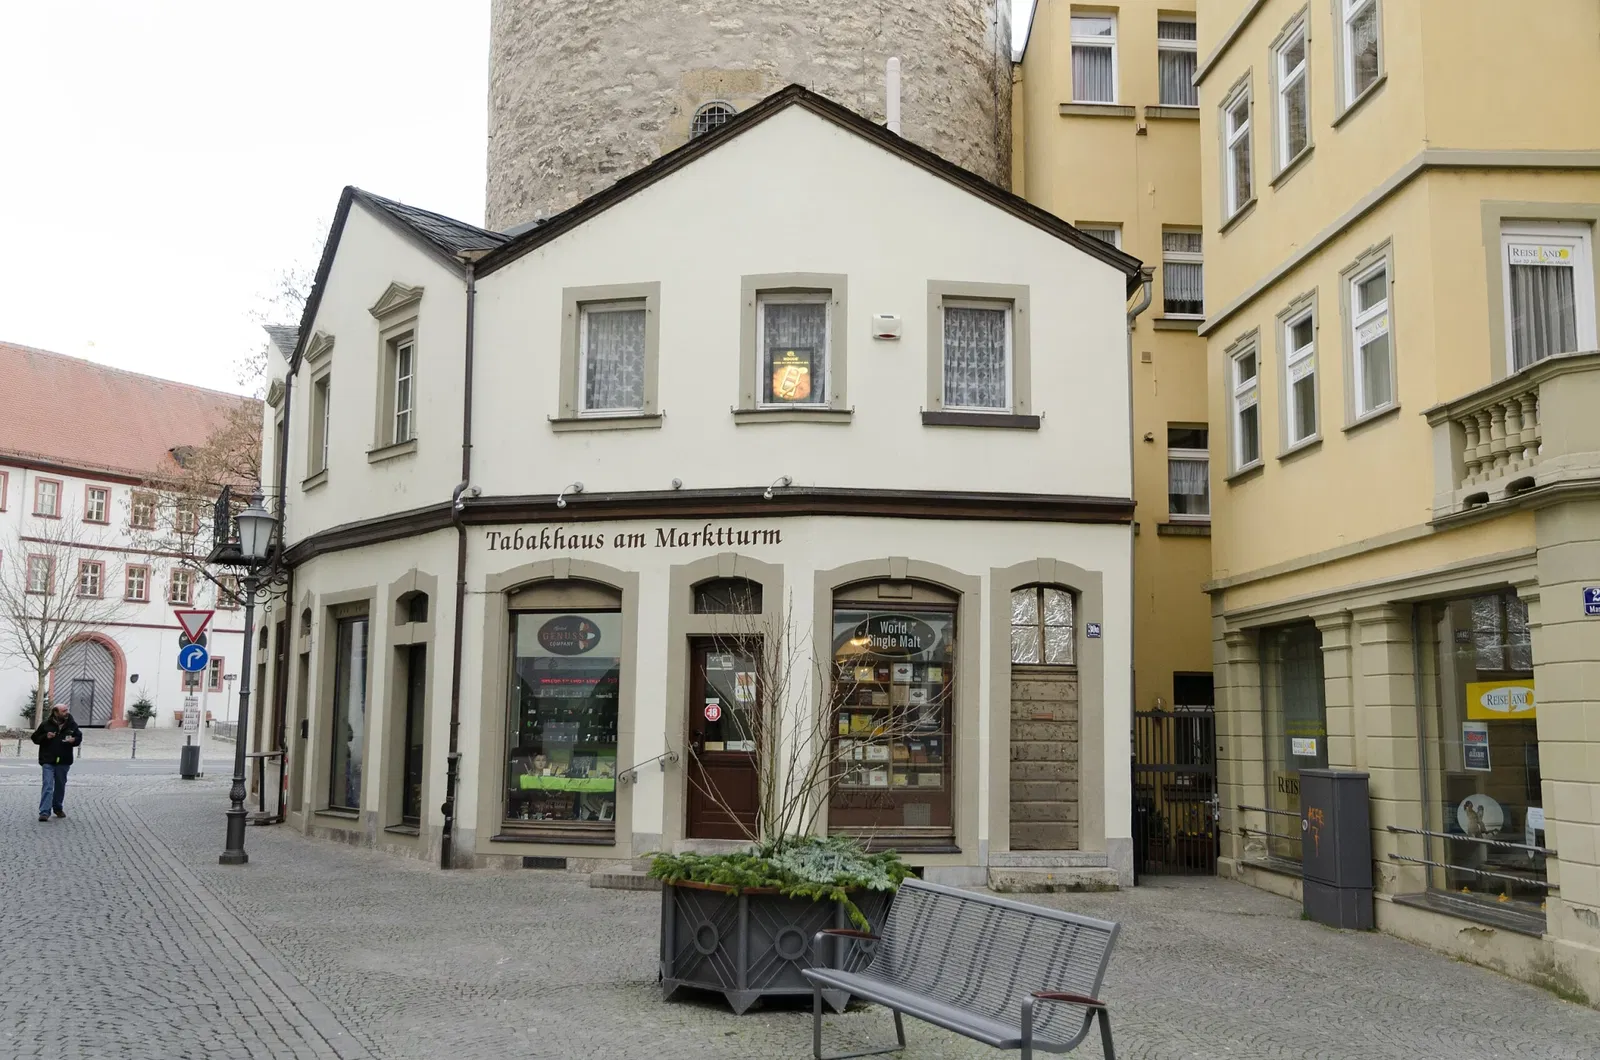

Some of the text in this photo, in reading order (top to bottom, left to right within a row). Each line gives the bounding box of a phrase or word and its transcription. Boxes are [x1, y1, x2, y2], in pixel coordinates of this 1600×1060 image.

[486, 523, 782, 551] Tabakhaus am Marktturm
[880, 620, 907, 634] World
[542, 631, 584, 641] GENUSS
[867, 634, 921, 649] Single Malt
[1277, 776, 1301, 795] REIS
